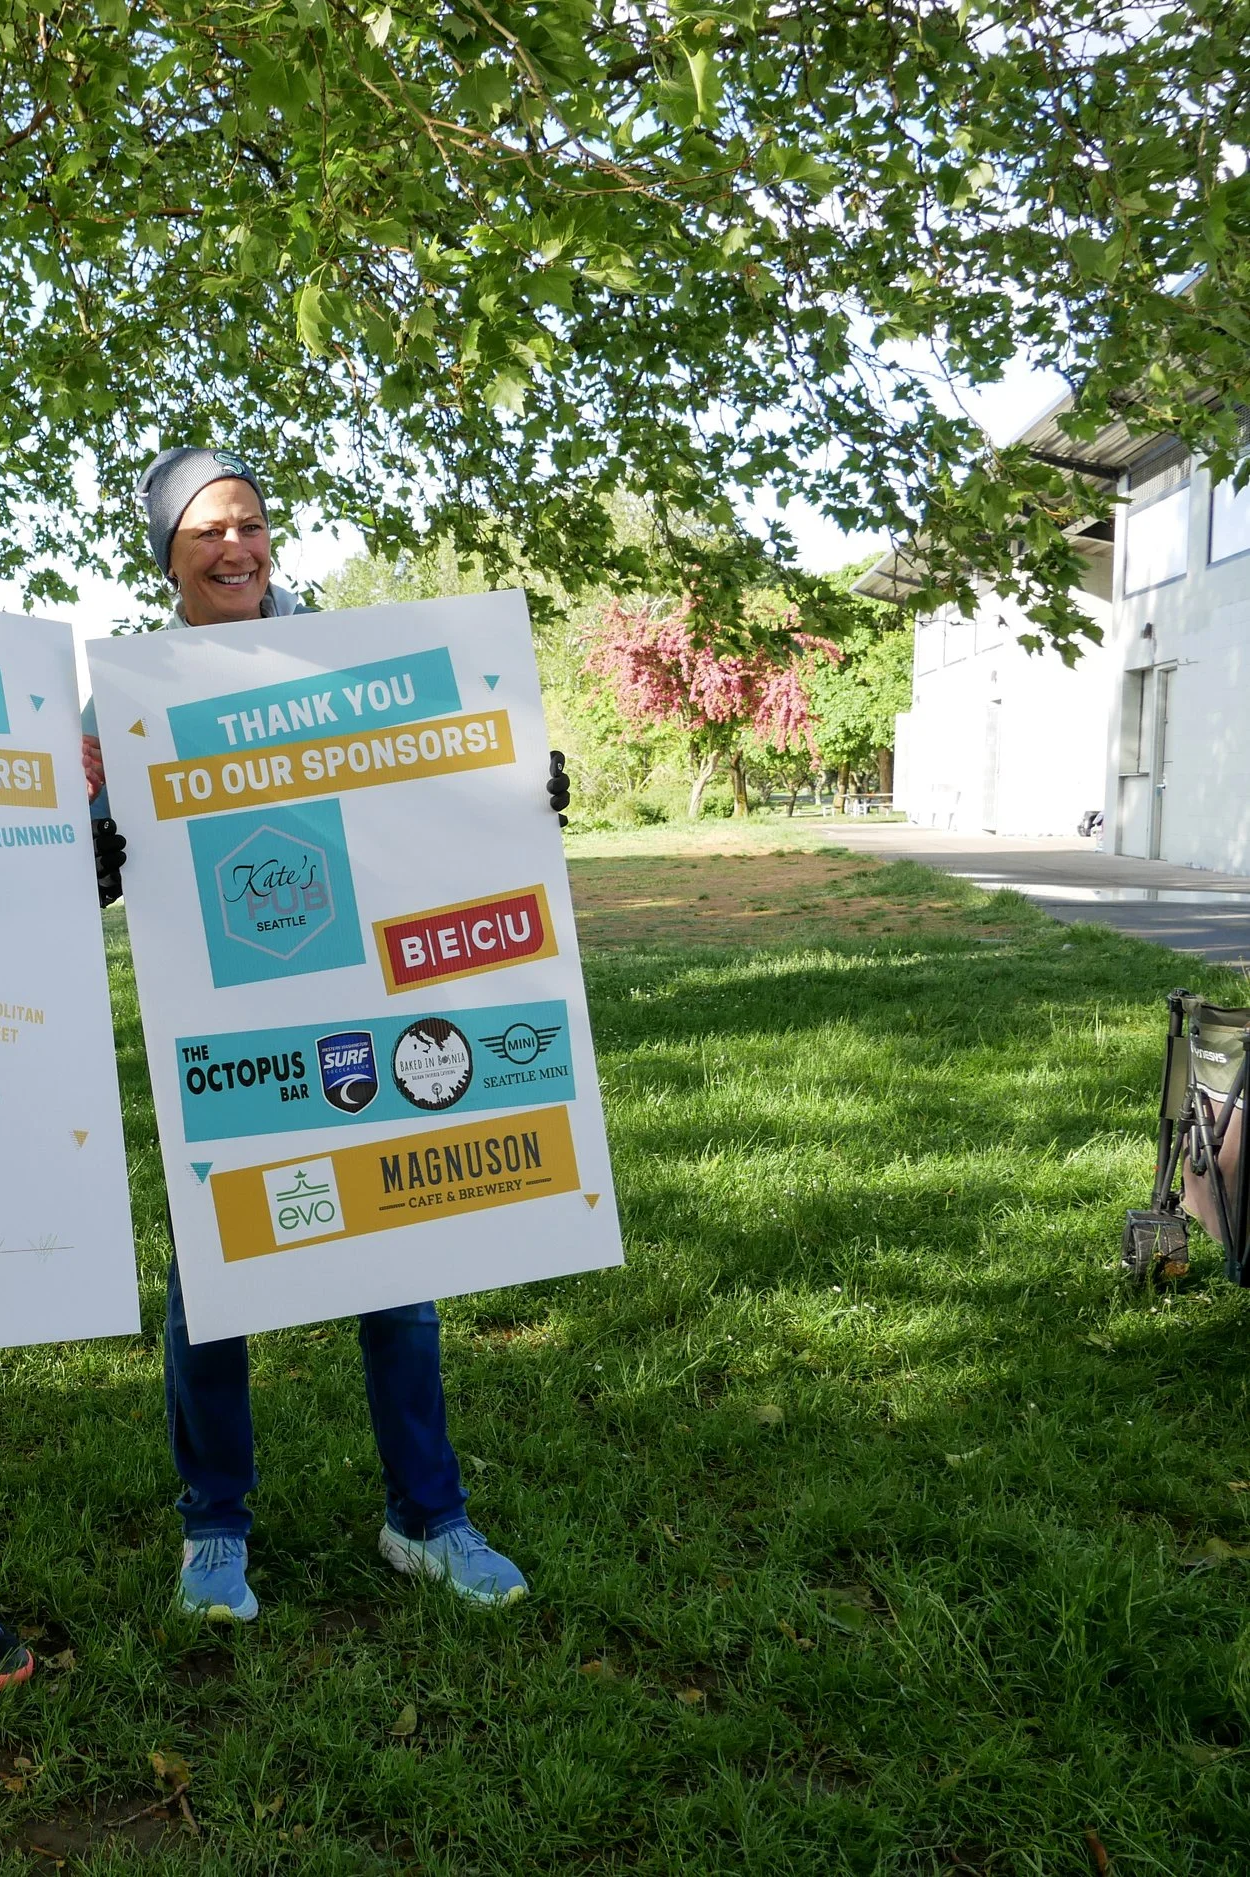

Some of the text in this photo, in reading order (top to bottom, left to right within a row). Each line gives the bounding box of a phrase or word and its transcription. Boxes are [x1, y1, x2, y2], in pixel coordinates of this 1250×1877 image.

[217, 673, 416, 746] THANK YOU
[164, 720, 500, 804] TO OUR SPONSORS!
[222, 855, 317, 902] Kate's
[247, 881, 329, 921] PUB
[256, 915, 307, 933] SEATTLE
[182, 1044, 209, 1063] THE
[323, 1047, 370, 1069] SURF
[507, 1036, 535, 1051] MINI
[186, 1051, 305, 1095] OCTOPUS
[399, 1059, 423, 1072] BAKED
[424, 1056, 435, 1068] IN
[483, 1065, 569, 1089] SEATTLE MINI
[280, 1083, 309, 1102] BAR
[379, 1131, 542, 1193] MAGNUSON
[408, 1179, 523, 1208] CAFE & BREWERY
[278, 1200, 335, 1230] evo
